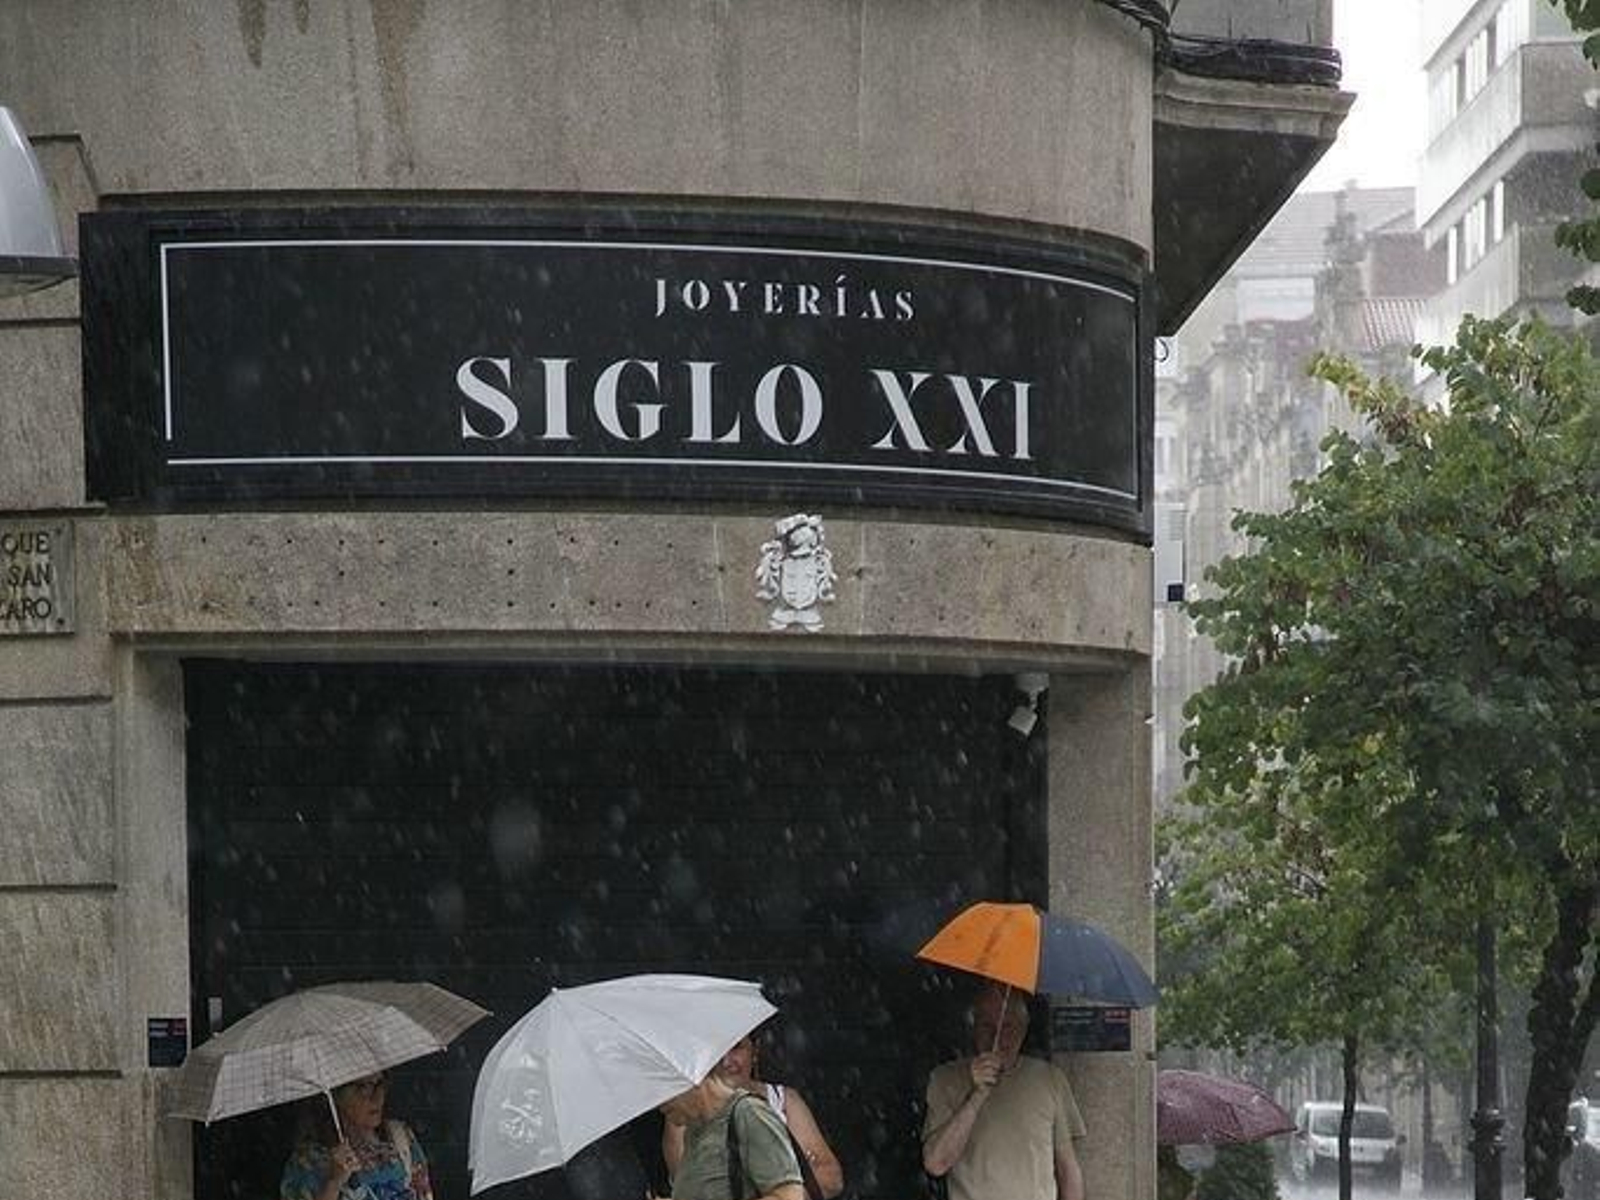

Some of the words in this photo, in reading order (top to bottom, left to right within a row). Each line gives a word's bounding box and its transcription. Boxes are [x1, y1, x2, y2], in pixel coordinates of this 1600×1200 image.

[655, 274, 914, 320] JOYERÍAS
[456, 357, 823, 446] SIGLO
[870, 369, 1032, 460] XXI
[8, 564, 50, 587] SAN
